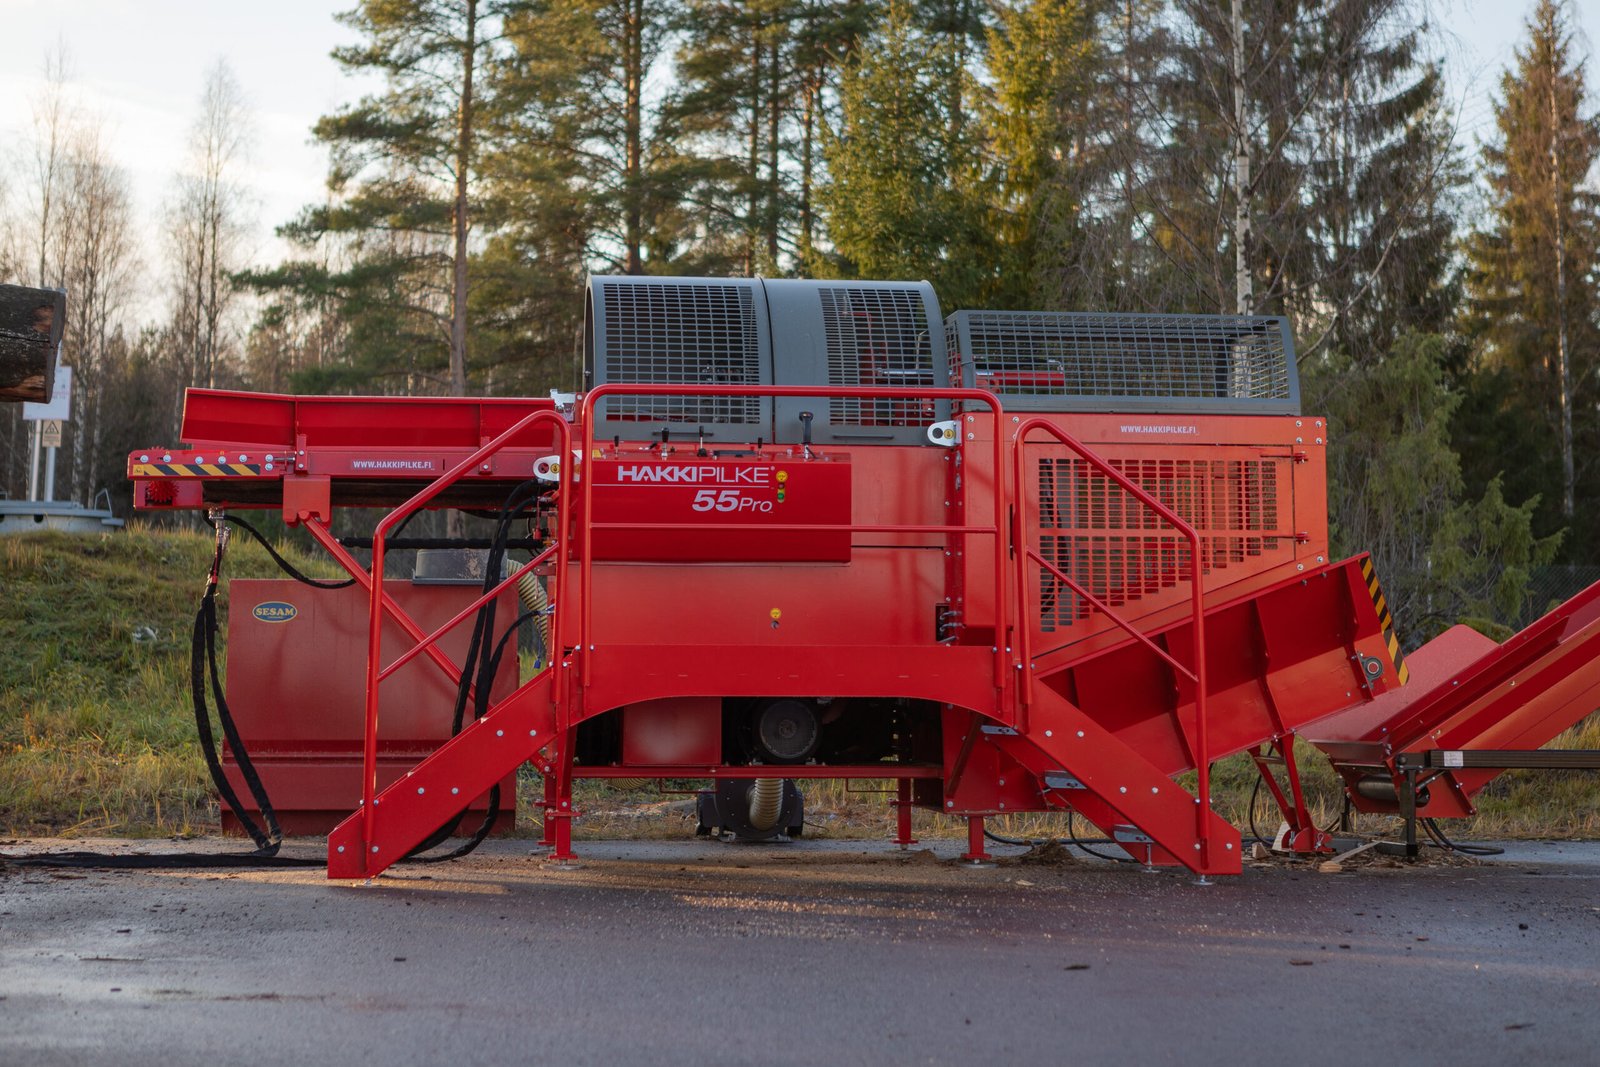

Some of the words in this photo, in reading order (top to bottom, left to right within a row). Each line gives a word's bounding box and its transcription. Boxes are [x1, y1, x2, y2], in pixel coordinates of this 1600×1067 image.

[1120, 425, 1196, 434] WWW.HAKKIPILKE.FI
[353, 461, 432, 469] WWW.HAKKIPILKE.FI
[255, 607, 294, 616] SESAM
